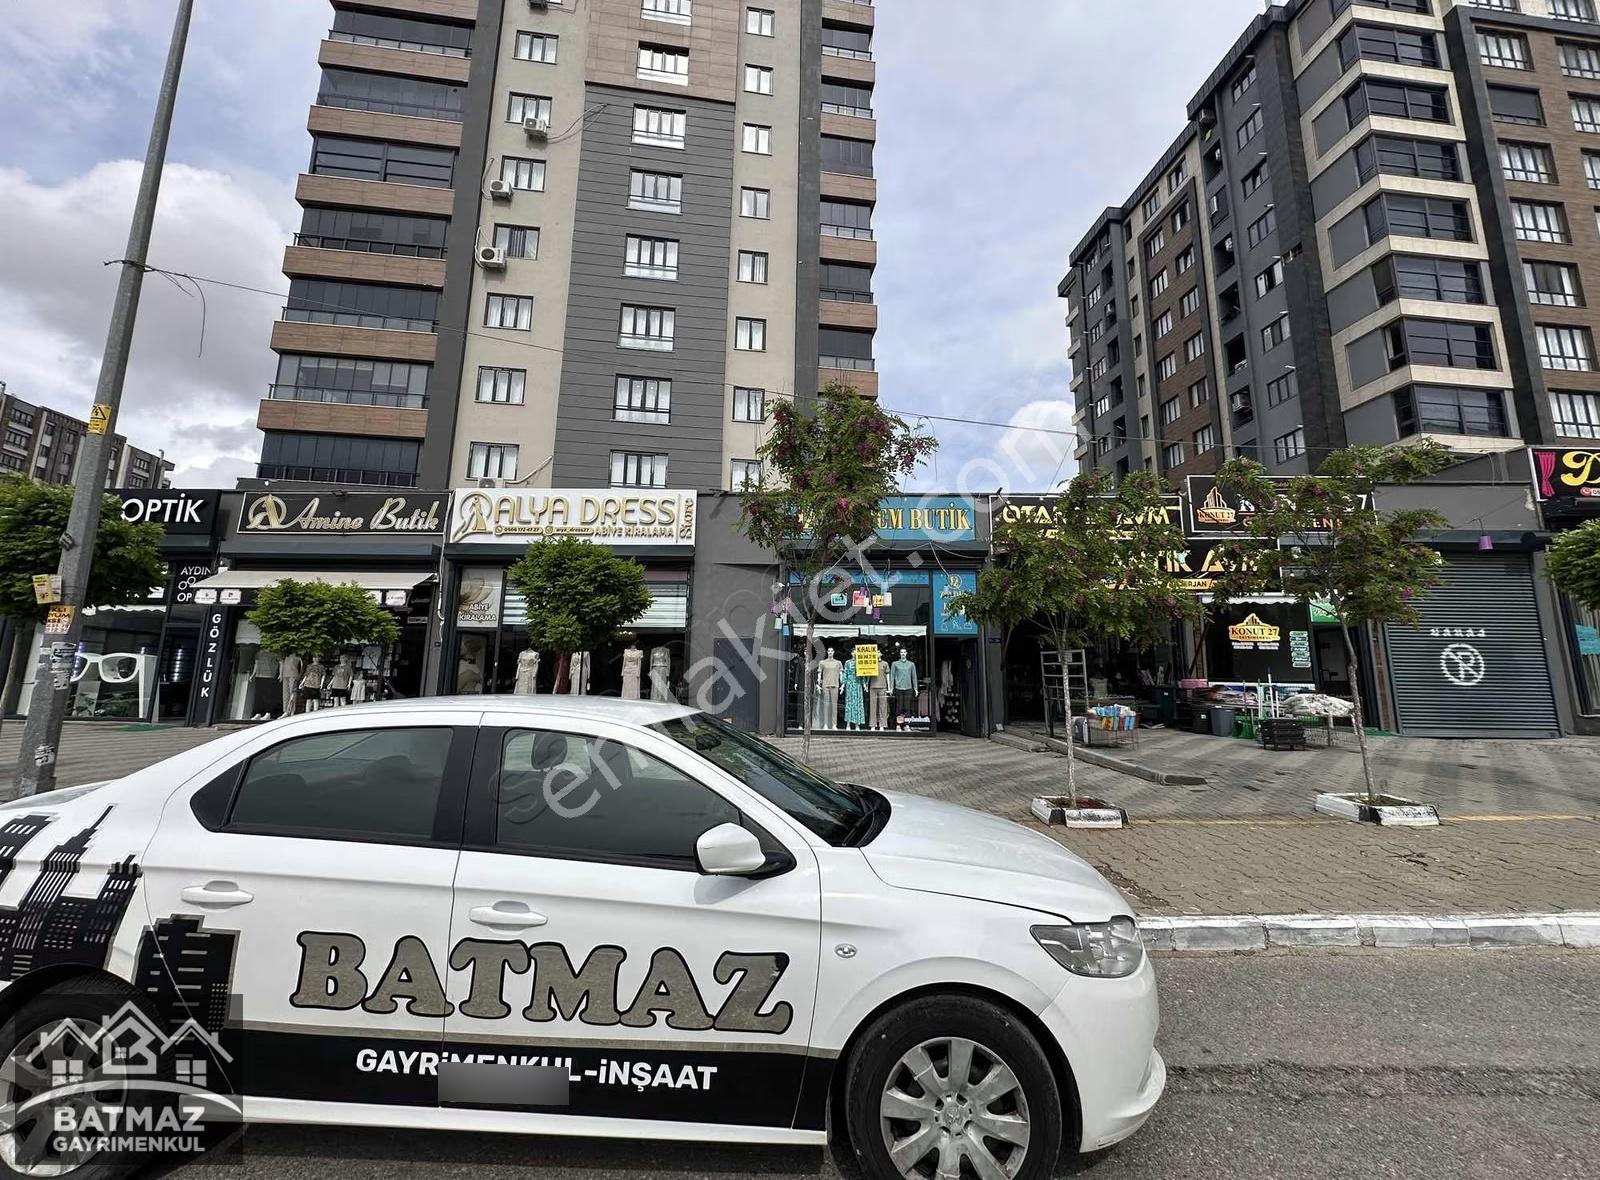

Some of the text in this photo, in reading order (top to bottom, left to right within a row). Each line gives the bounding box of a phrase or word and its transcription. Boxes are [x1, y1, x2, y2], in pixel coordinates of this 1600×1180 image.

[120, 492, 204, 523] OPTİK
[294, 497, 440, 530] Amine Butik
[494, 495, 676, 525] ALYA DRESS
[679, 498, 694, 539] Store
[910, 503, 972, 530] BUTİK
[594, 525, 674, 538] ABİYE KİRALAMA
[180, 566, 212, 576] AYDIN
[458, 611, 498, 622] KİRALAMA
[468, 602, 490, 611] ABİYE
[1231, 627, 1278, 636] KONUT 27
[199, 613, 223, 698] GÖZLÜK
[289, 930, 794, 1034] BATMAZ
